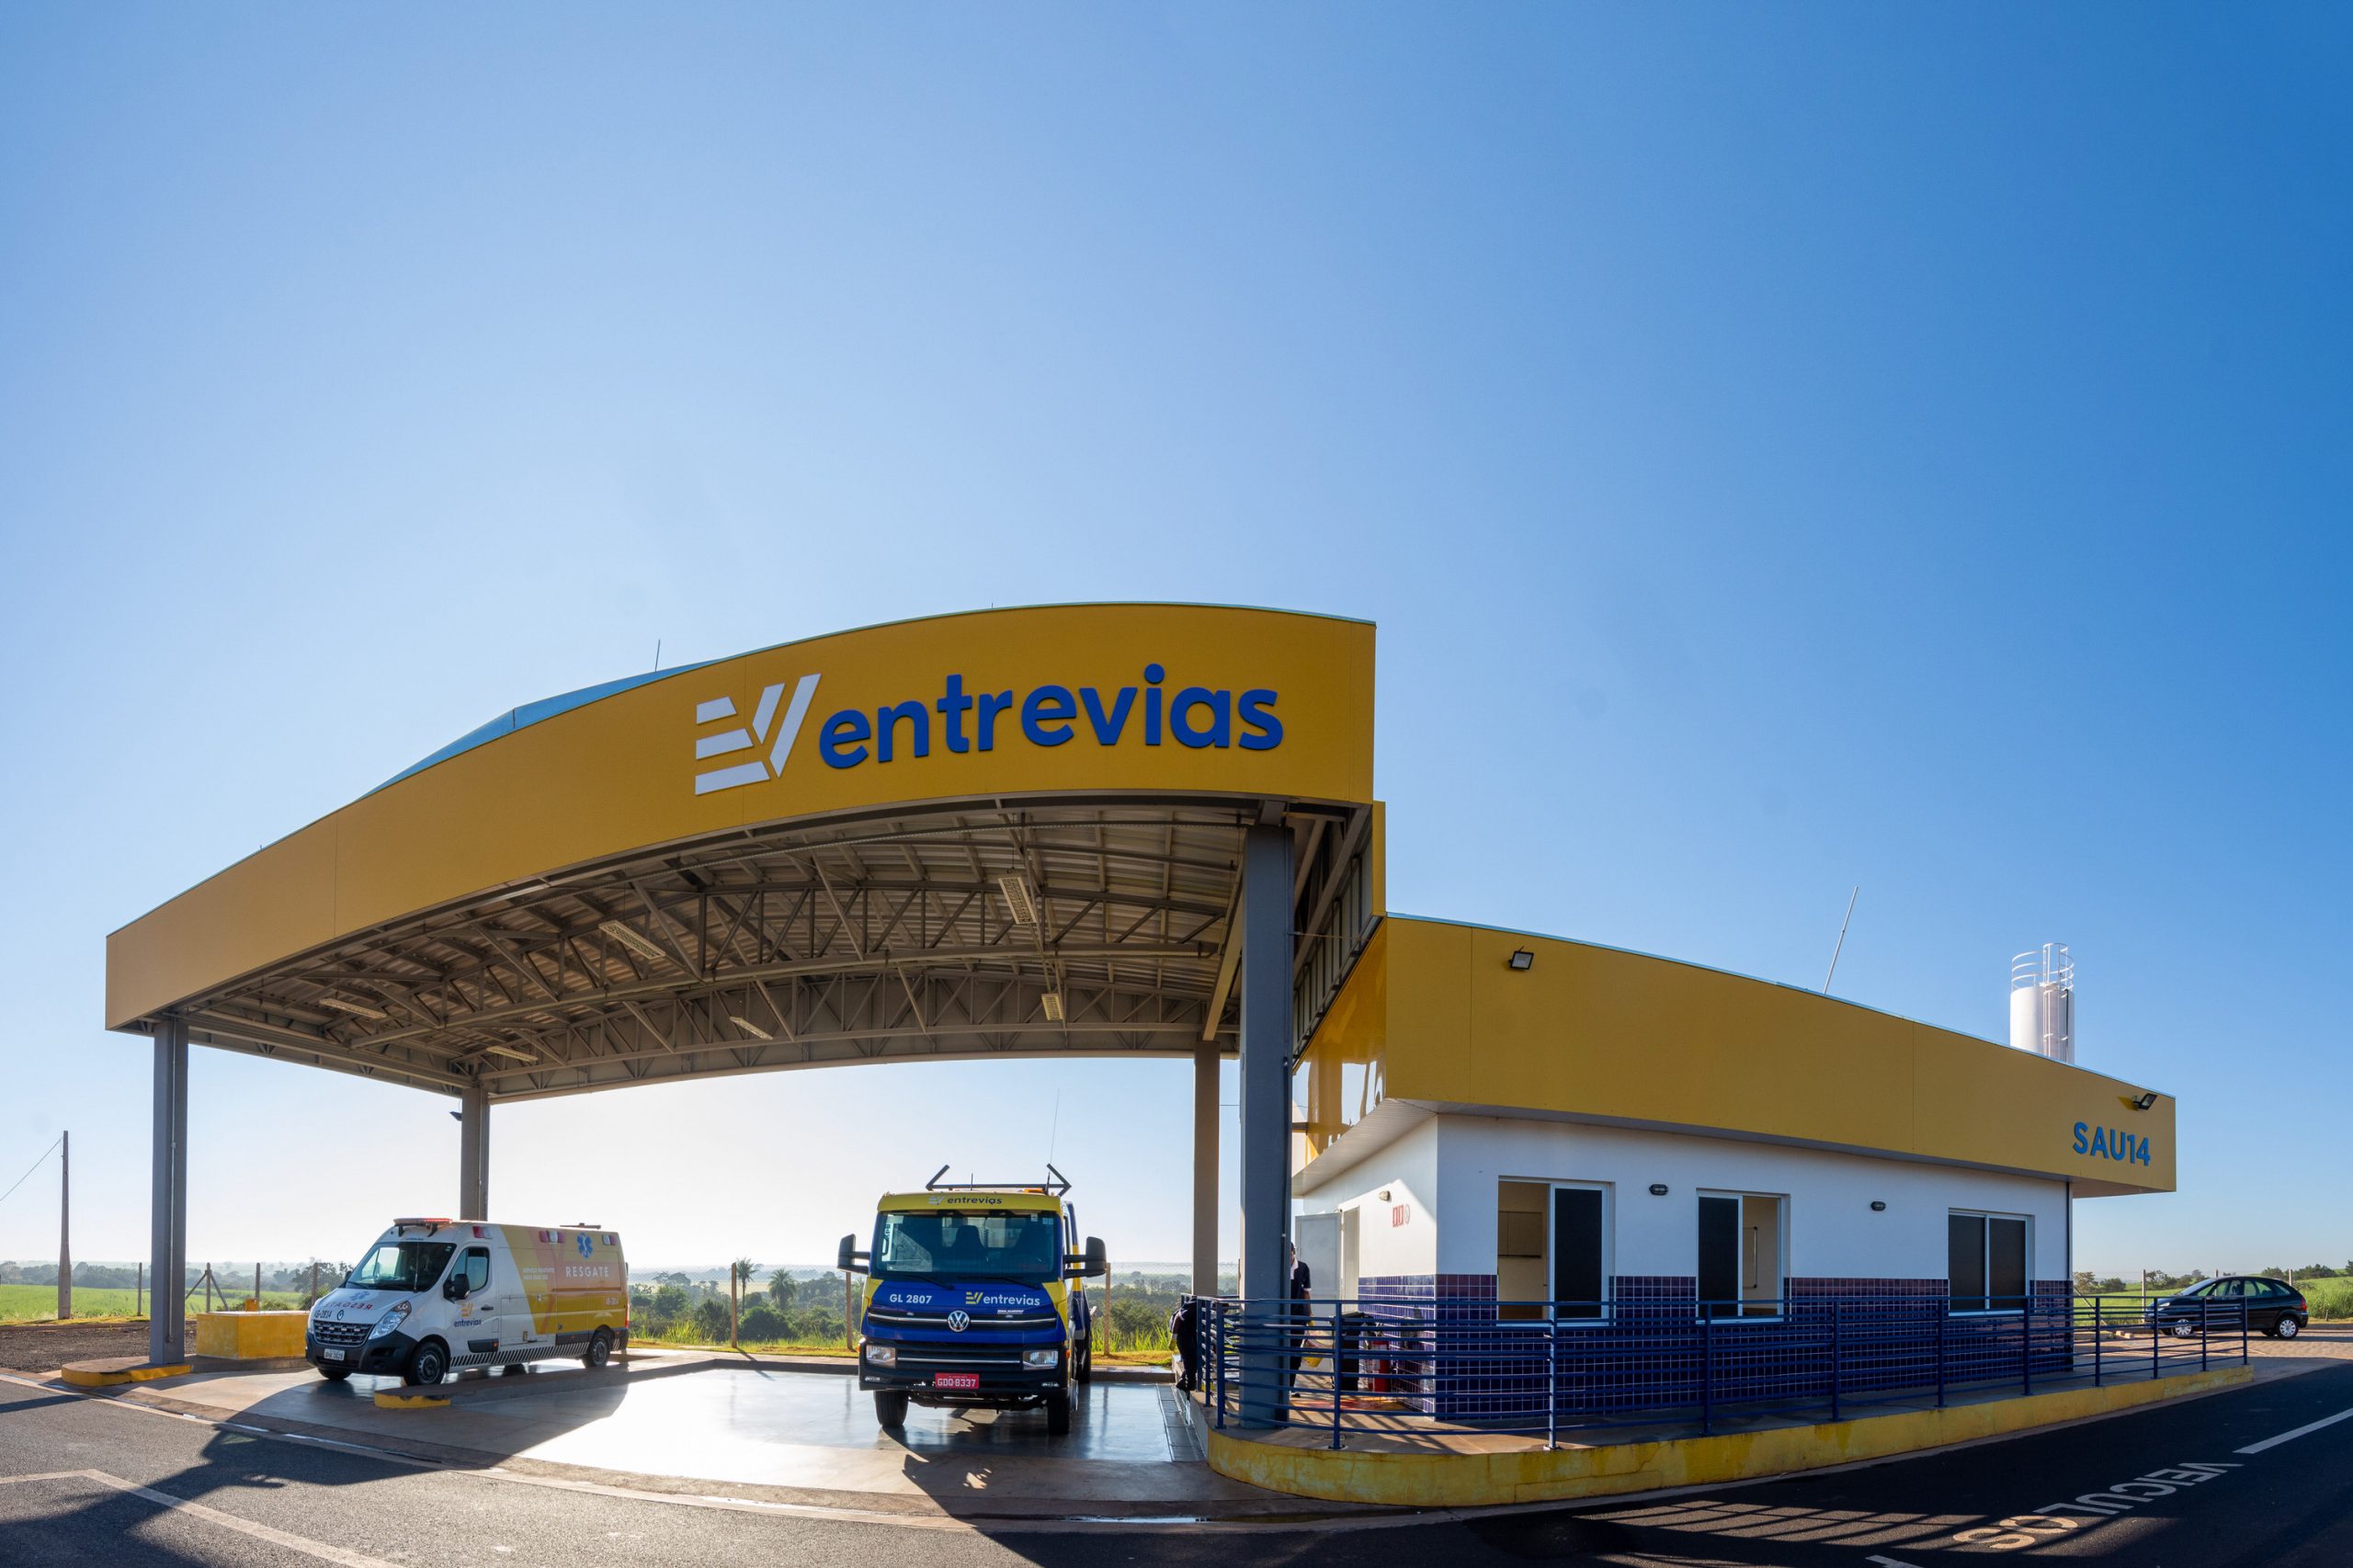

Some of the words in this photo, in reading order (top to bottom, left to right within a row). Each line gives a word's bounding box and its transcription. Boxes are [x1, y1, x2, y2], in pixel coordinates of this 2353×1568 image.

[819, 663, 1285, 769] entrevias
[2073, 1121, 2151, 1167] SAU14
[947, 1196, 1003, 1205] entrevias
[565, 1266, 610, 1278] RESGATE
[890, 1293, 904, 1303] GL
[905, 1294, 933, 1304] 2807
[983, 1293, 1040, 1306] entrevias
[453, 1318, 483, 1328] entrevias
